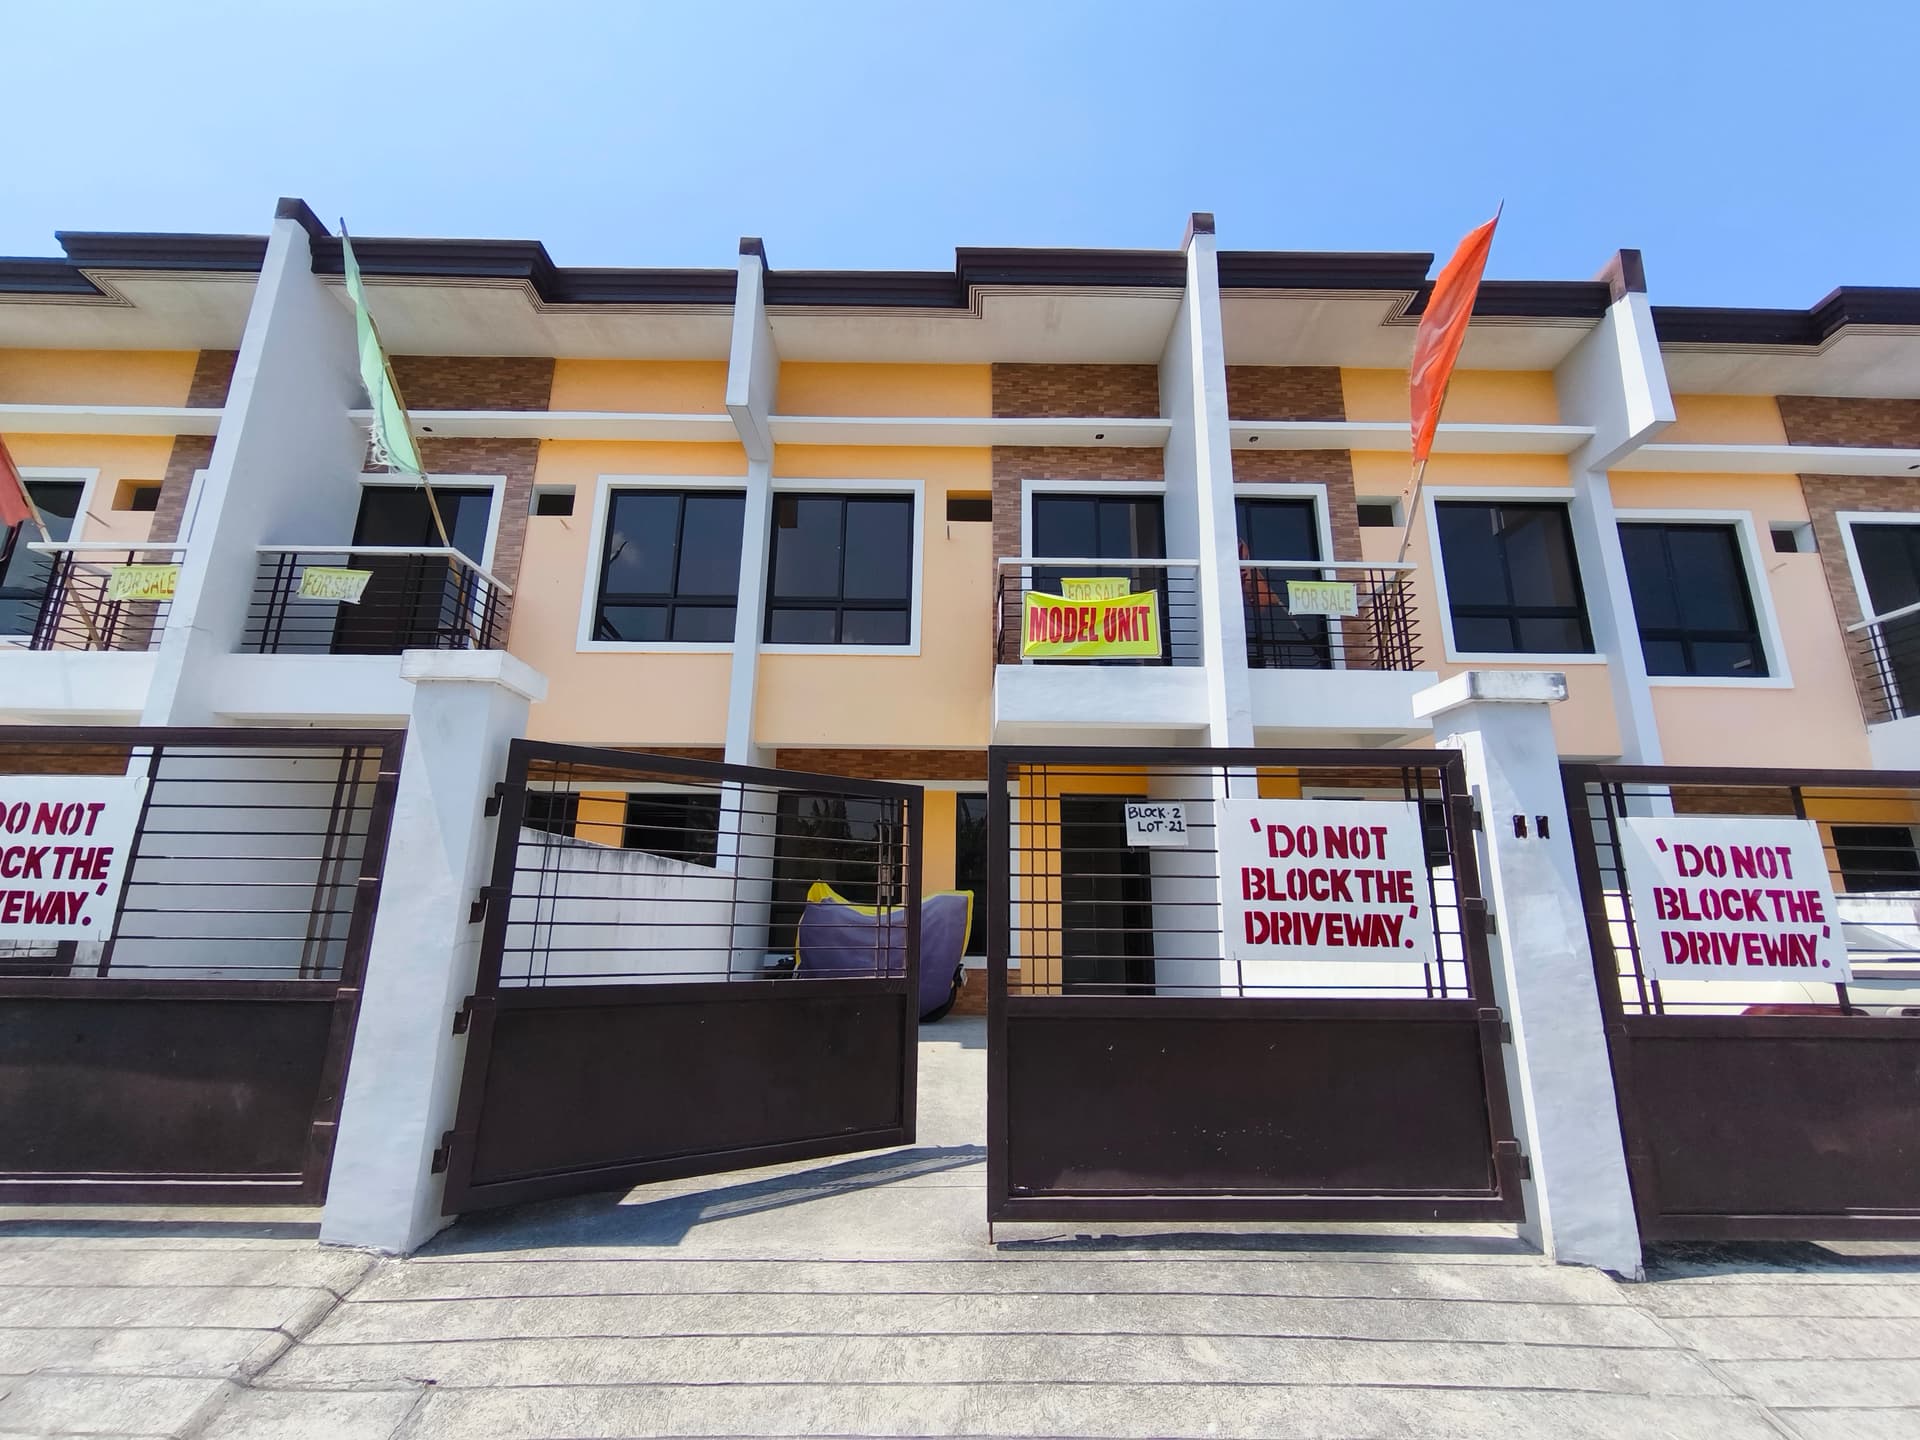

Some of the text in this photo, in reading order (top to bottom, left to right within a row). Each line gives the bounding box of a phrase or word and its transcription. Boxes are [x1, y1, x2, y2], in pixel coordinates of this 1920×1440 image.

[116, 571, 177, 595] FOR SALE
[1294, 587, 1352, 612] FOR SALE
[1029, 606, 1151, 643] MODEL UNIT
[0, 801, 106, 836] O NOT
[1323, 826, 1387, 860] NOT
[53, 846, 114, 880] THE
[1729, 846, 1793, 880] NOT
[1241, 867, 1415, 903] BLOCK THE
[1653, 887, 1826, 923] BLOCK THE
